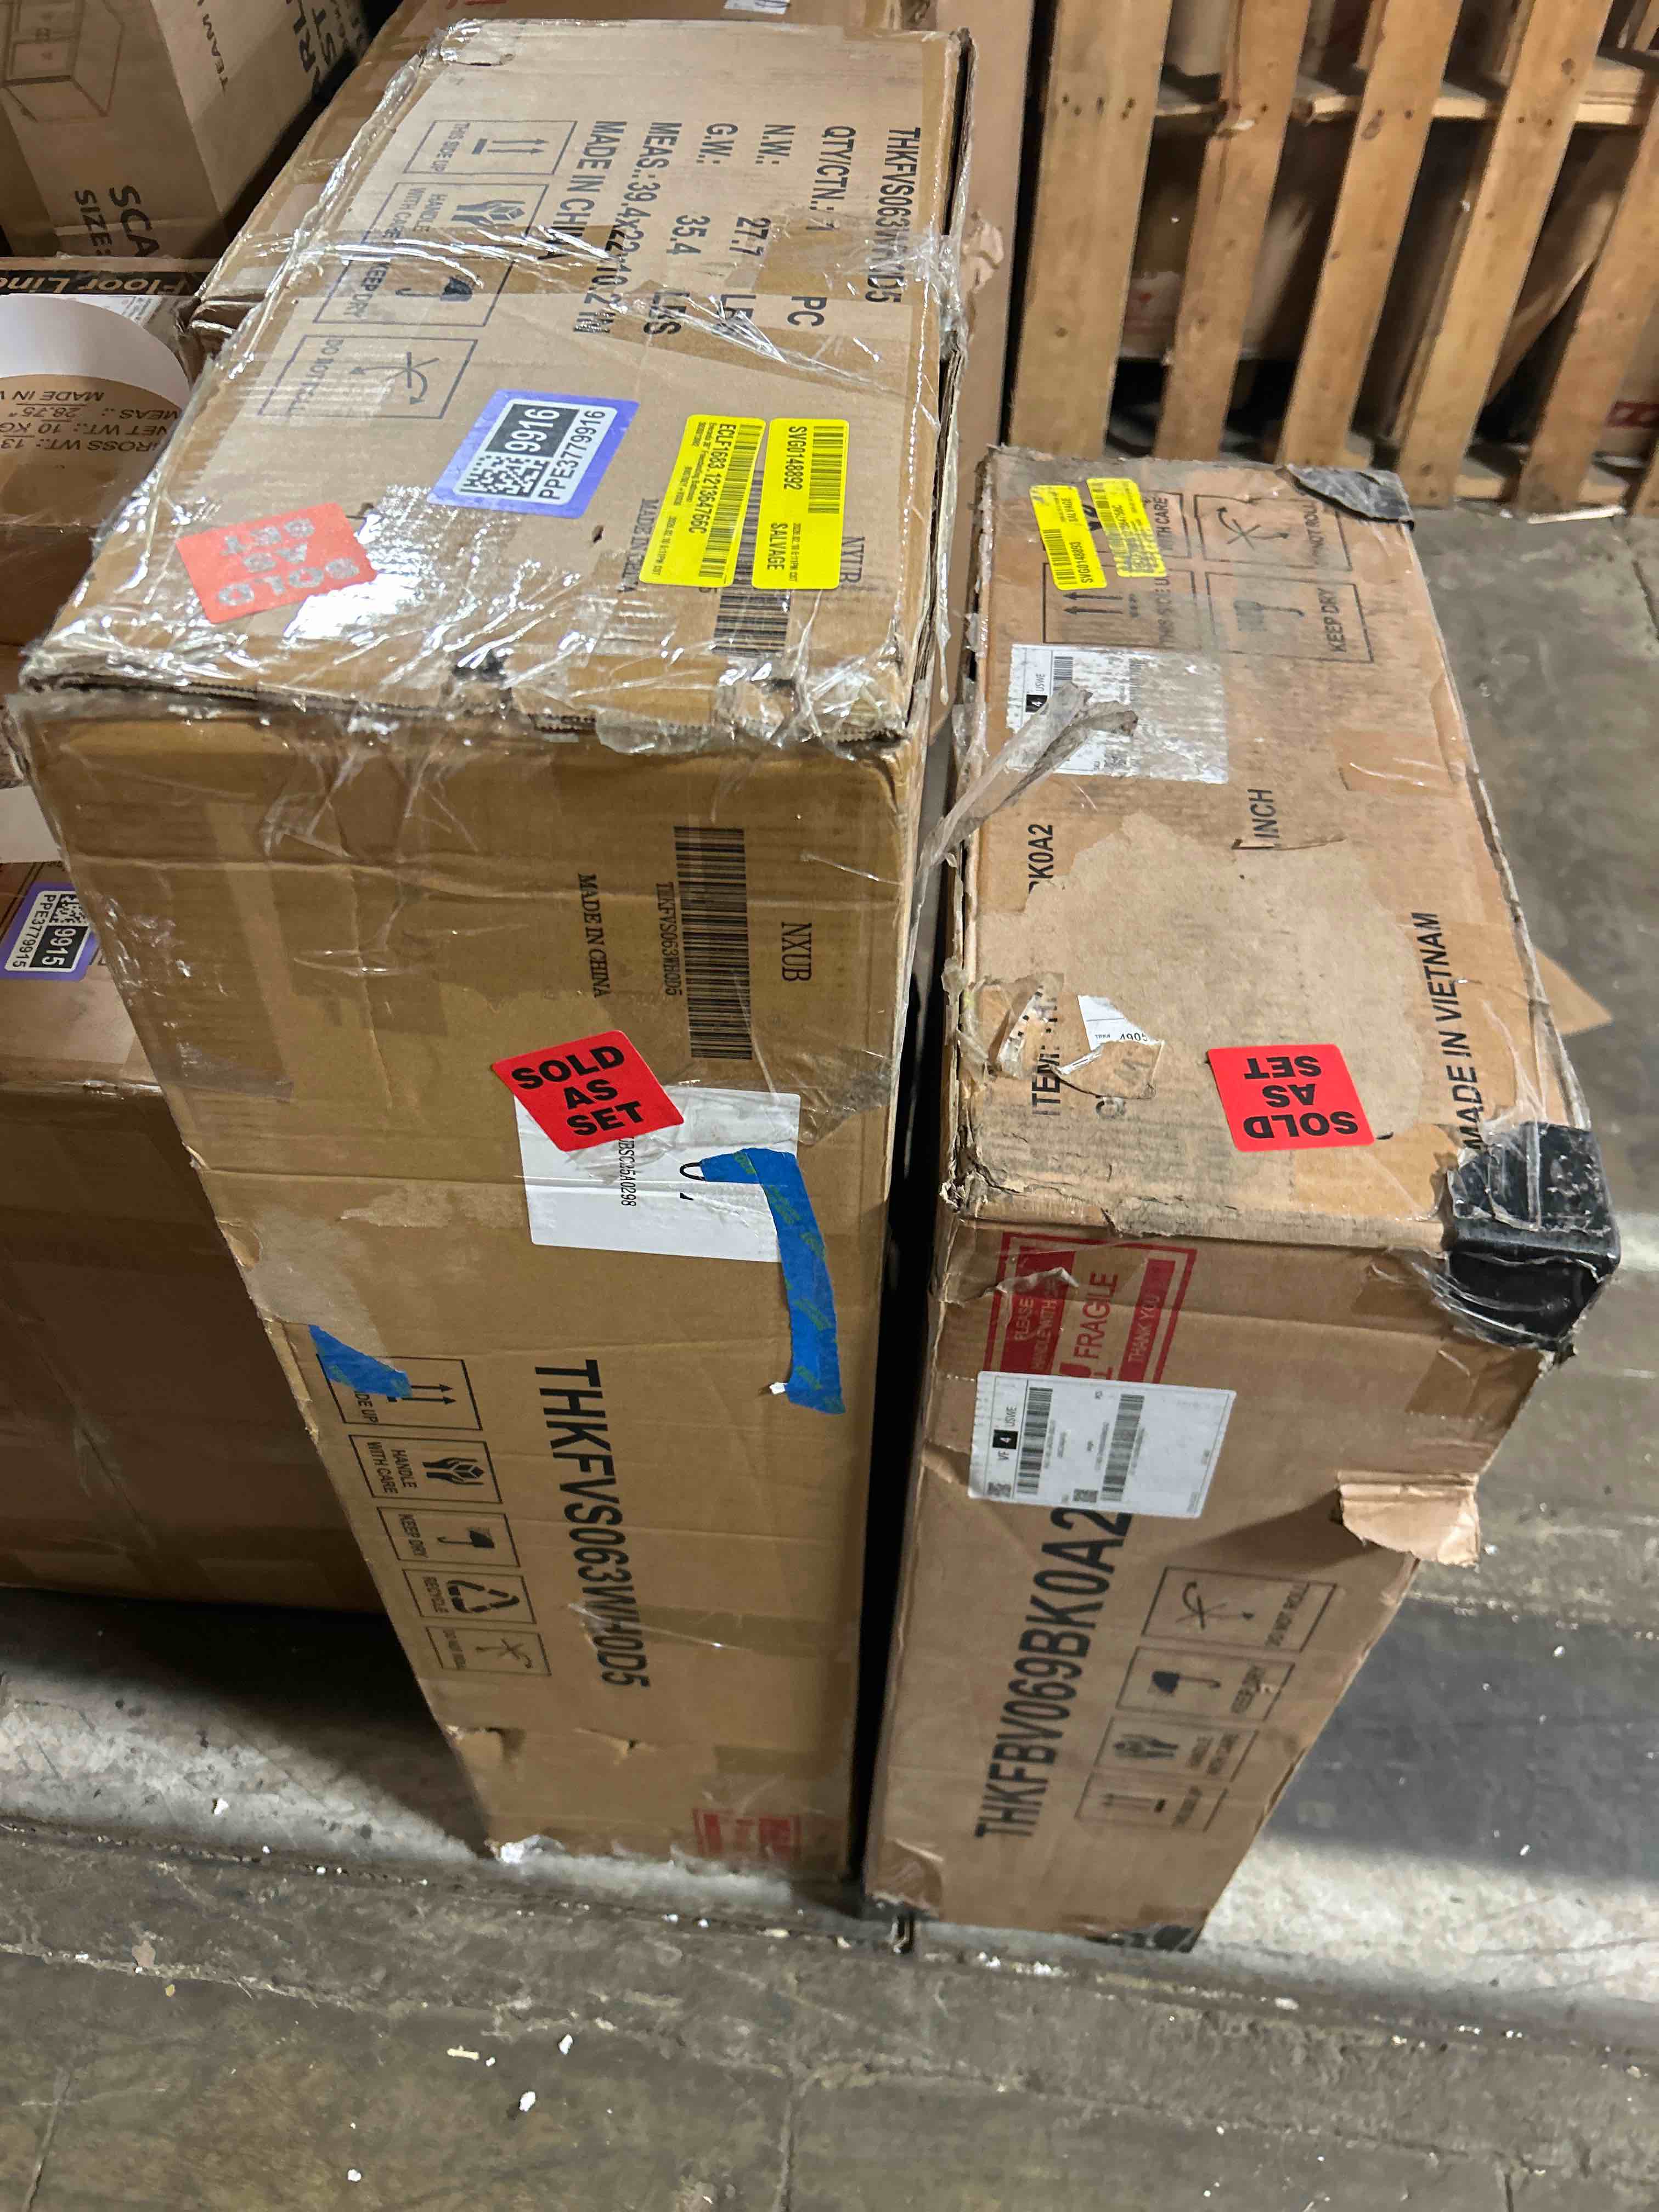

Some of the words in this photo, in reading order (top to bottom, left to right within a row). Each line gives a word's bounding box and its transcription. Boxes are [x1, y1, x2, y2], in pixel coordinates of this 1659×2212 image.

[446, 122, 470, 141] THIS
[576, 121, 627, 170] MADE
[697, 123, 738, 165] G.W.:
[755, 124, 795, 165] N.W.:
[430, 160, 449, 173] UP
[436, 141, 460, 159] SIDE
[567, 175, 606, 193] IN
[809, 126, 856, 211] QTY/CTN.:
[399, 188, 426, 211] WITH
[413, 193, 448, 233] HANDLE
[665, 215, 710, 256] 35.4
[729, 216, 772, 257] 27.7
[78, 278, 185, 295] Floor
[360, 260, 391, 291] KEEP
[342, 293, 373, 318] DRY
[787, 296, 827, 328] PC
[12, 390, 36, 400] IN
[39, 390, 105, 402] MADE
[37, 423, 61, 435] 10
[505, 404, 561, 452] 9916
[87, 439, 159, 452] ROSS
[538, 410, 606, 500] PPE3779916
[783, 425, 808, 490] SVG0148892
[1153, 495, 1171, 527] CARE
[222, 516, 315, 556] SET
[767, 522, 788, 571] SALVAGE
[242, 542, 309, 573] AS
[215, 556, 360, 607] SOLD
[1318, 588, 1339, 614] DRY
[1324, 617, 1347, 653] KEEP
[1035, 673, 1045, 692] USWE
[1031, 697, 1042, 707] 4
[1246, 788, 1280, 839] INCH
[1027, 823, 1054, 895] K0A2
[578, 873, 602, 924] MADE
[12, 894, 57, 968] PPE3779915
[41, 927, 77, 966] 9915
[585, 927, 606, 946] IN
[781, 921, 812, 983] NXUB
[1410, 912, 1463, 1023] VIETNAM
[588, 947, 612, 998] CHINA
[1438, 1030, 1474, 1058] IN
[511, 1045, 625, 1090] SOLD
[1243, 1055, 1322, 1080] SET
[564, 1078, 618, 1111] AS
[1261, 1083, 1316, 1108] AS
[1446, 1063, 1485, 1152] MADE
[565, 1101, 645, 1137] SET
[1243, 1111, 1359, 1139] SOLD
[1014, 1299, 1035, 1342] PLEASE
[1073, 1272, 1119, 1359] FRAGILE
[1127, 1319, 1153, 1363] THANK
[1141, 1295, 1160, 1318] YOU
[354, 1391, 374, 1408] DE
[361, 1409, 379, 1425] UP
[1004, 1406, 1017, 1427] USWE
[366, 1441, 389, 1466] WITH
[1000, 1436, 1012, 1444] 4
[376, 1468, 399, 1494] CARE
[390, 1448, 418, 1489] HANDLE
[398, 1514, 421, 1538] KEEP
[534, 1358, 651, 1688] THKFVS063WH0D5
[408, 1539, 429, 1559] DRY
[974, 1506, 1133, 1838] THKFBV069BK0A2
